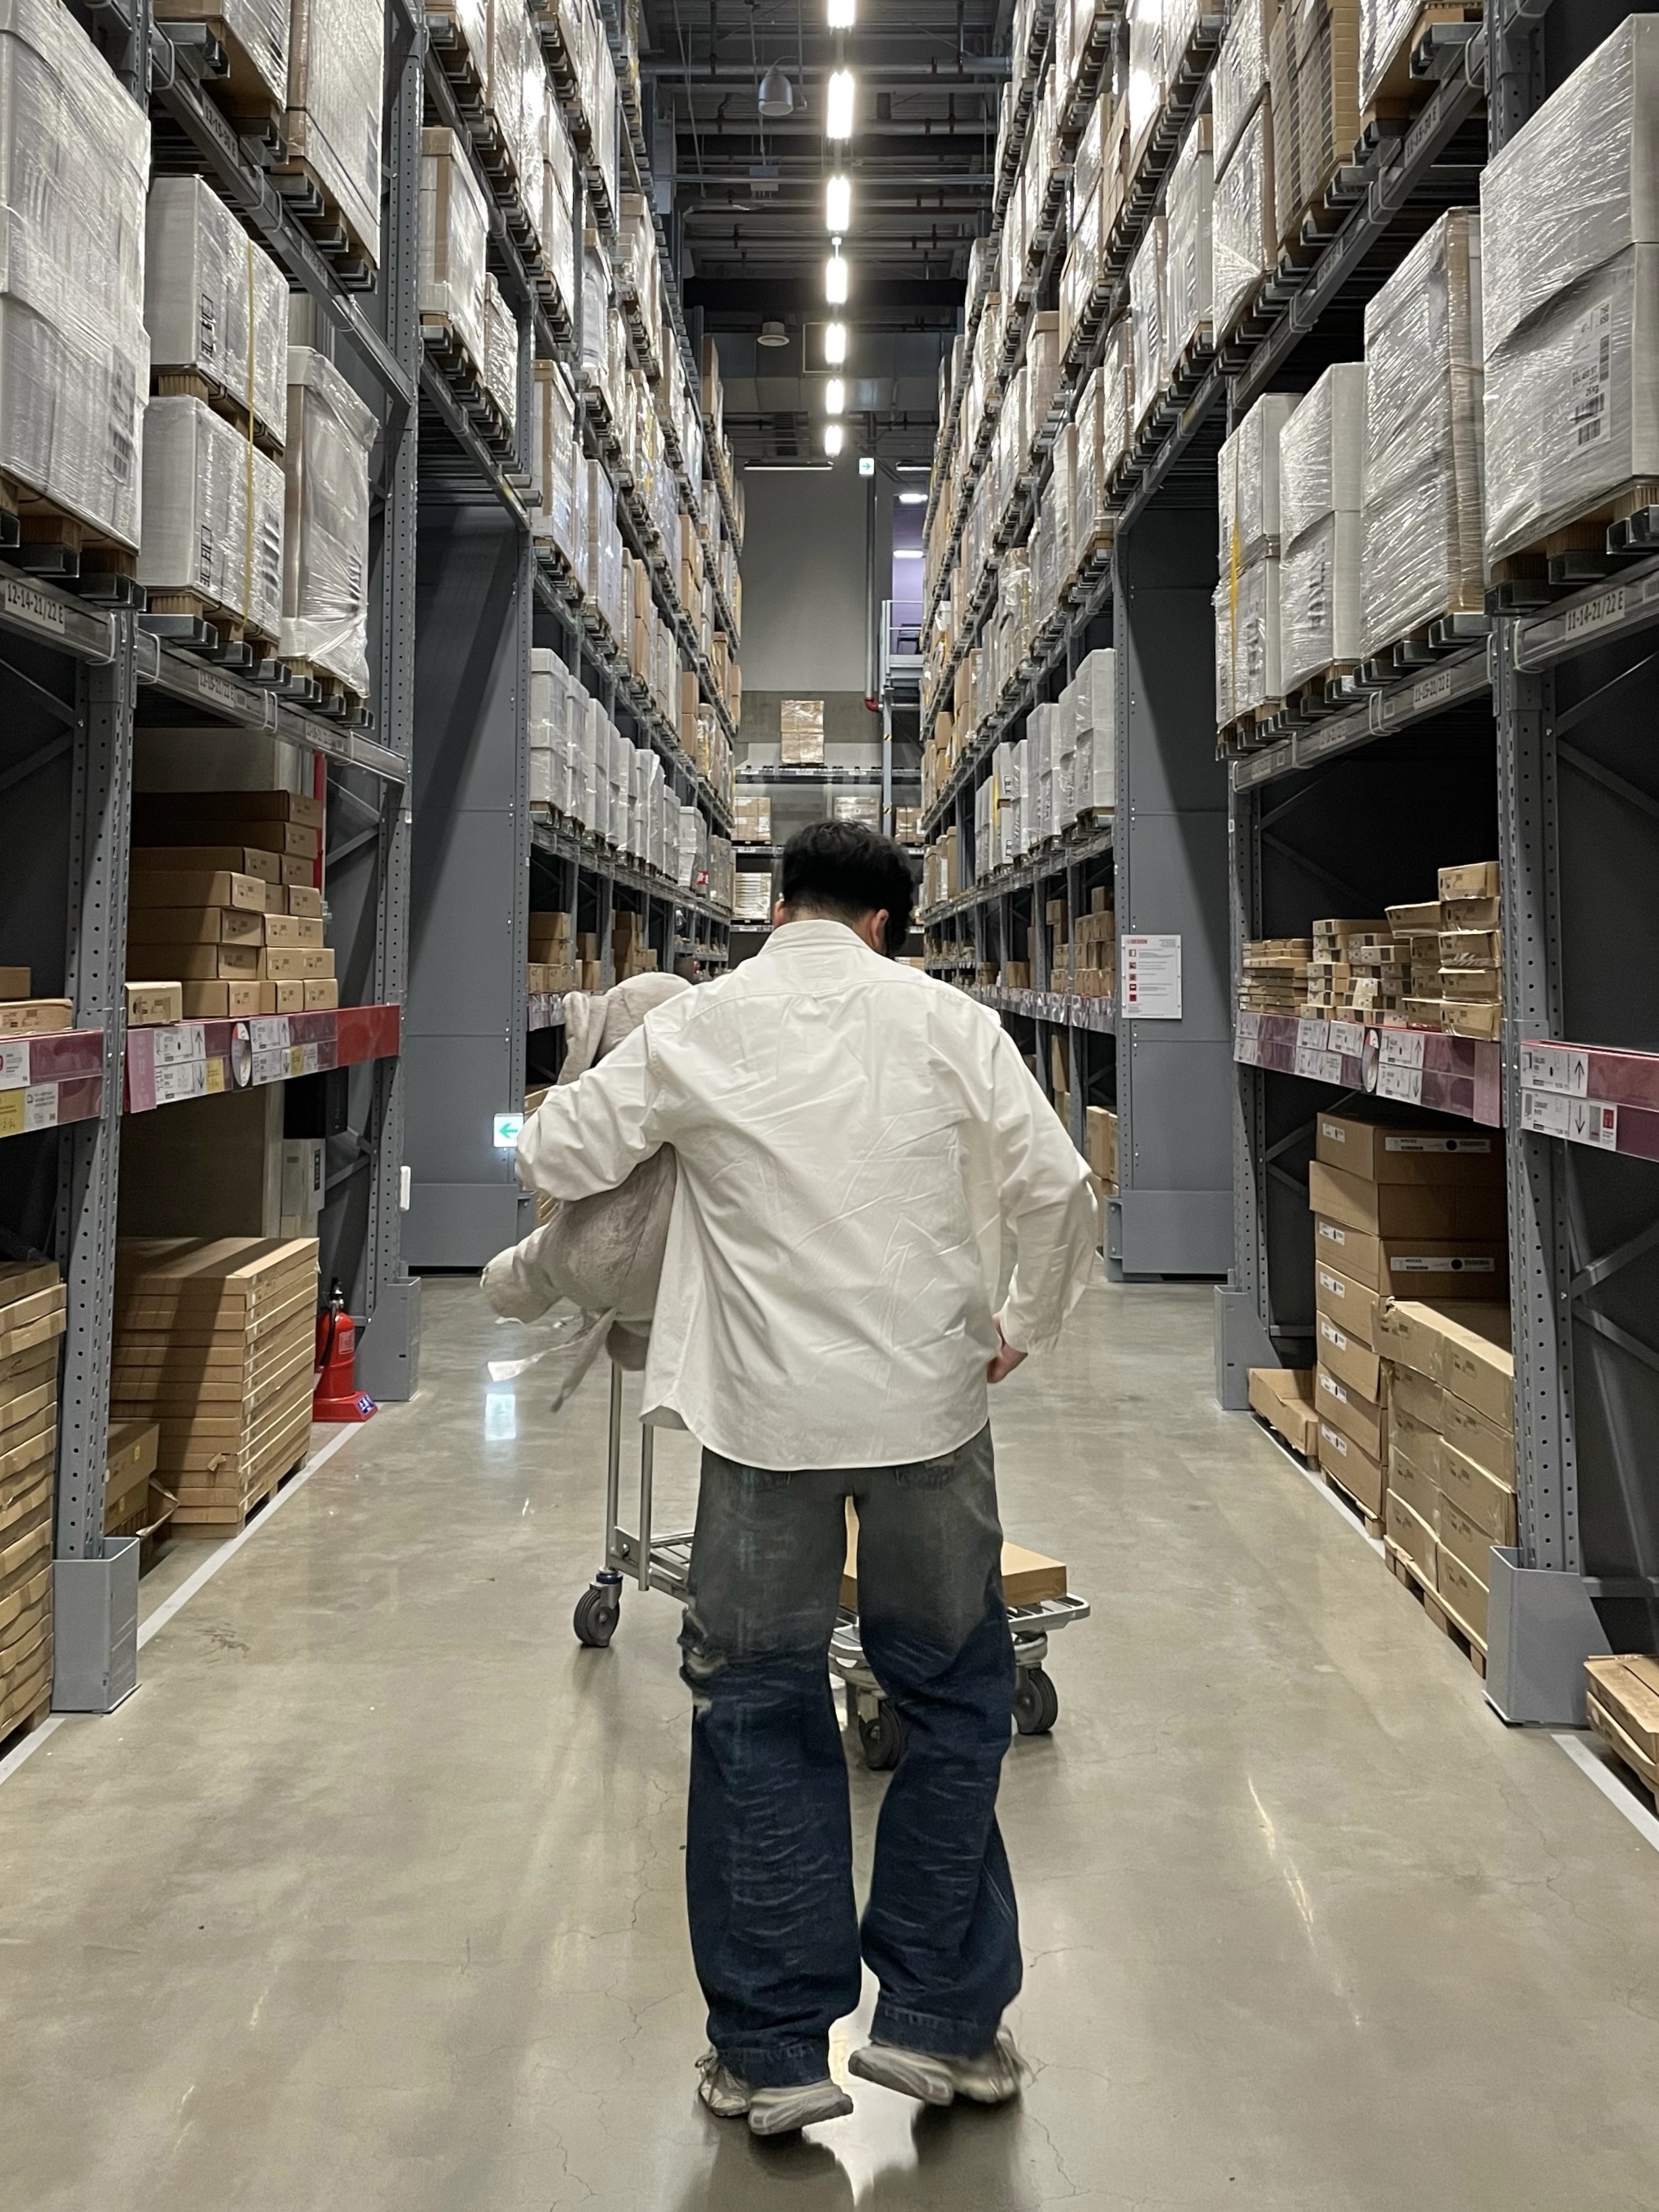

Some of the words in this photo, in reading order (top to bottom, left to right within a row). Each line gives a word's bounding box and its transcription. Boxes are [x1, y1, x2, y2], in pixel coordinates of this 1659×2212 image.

[7, 582, 57, 621] 12-14-21/22
[59, 606, 64, 624] E
[1567, 593, 1616, 631] 11-14-21/22
[1618, 590, 1623, 610] E
